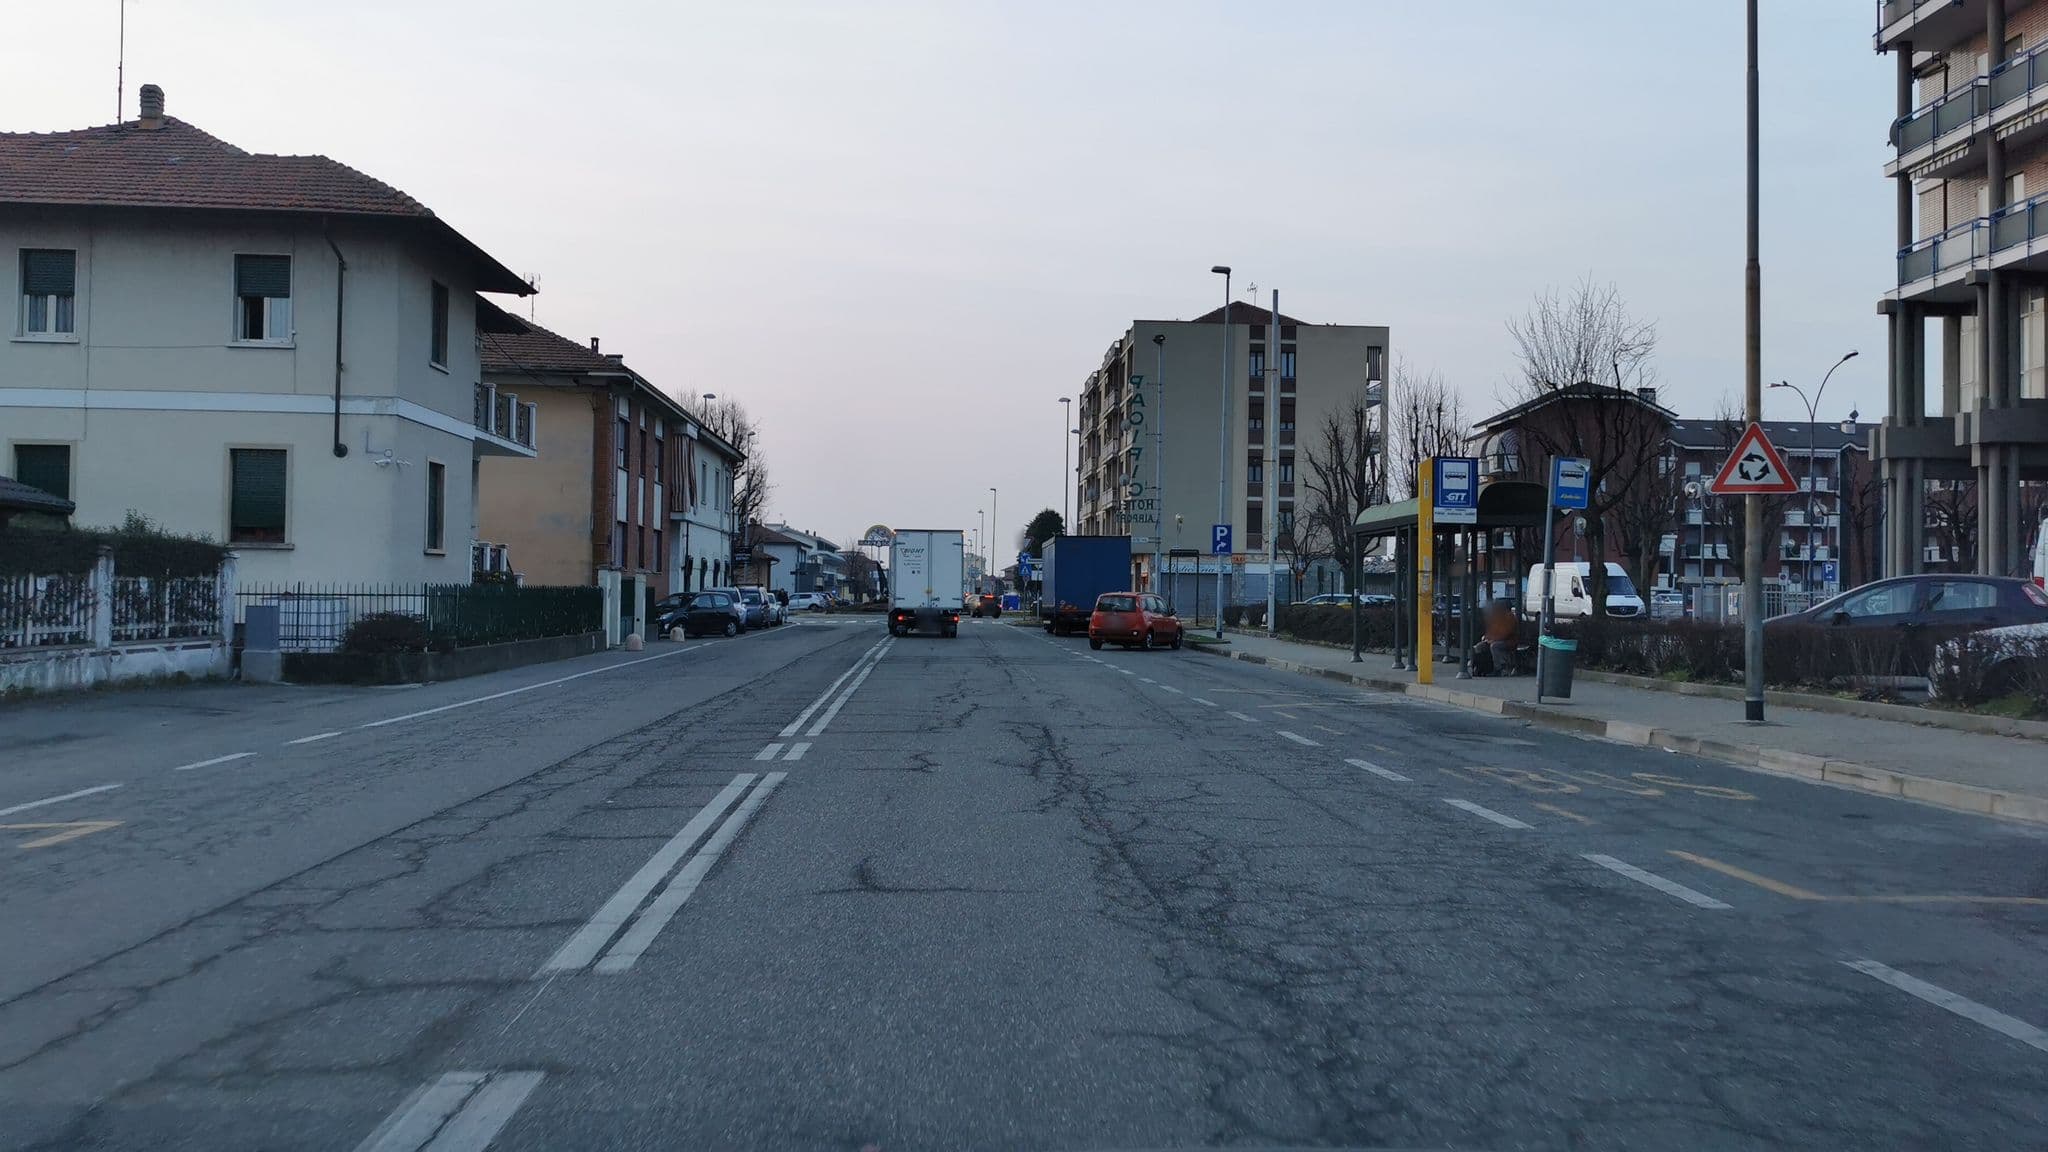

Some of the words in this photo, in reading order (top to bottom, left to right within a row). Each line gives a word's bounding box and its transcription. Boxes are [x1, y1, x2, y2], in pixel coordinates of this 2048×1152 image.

[1446, 492, 1467, 501] GTT
[1216, 526, 1228, 541] P
[1825, 564, 1833, 574] P
